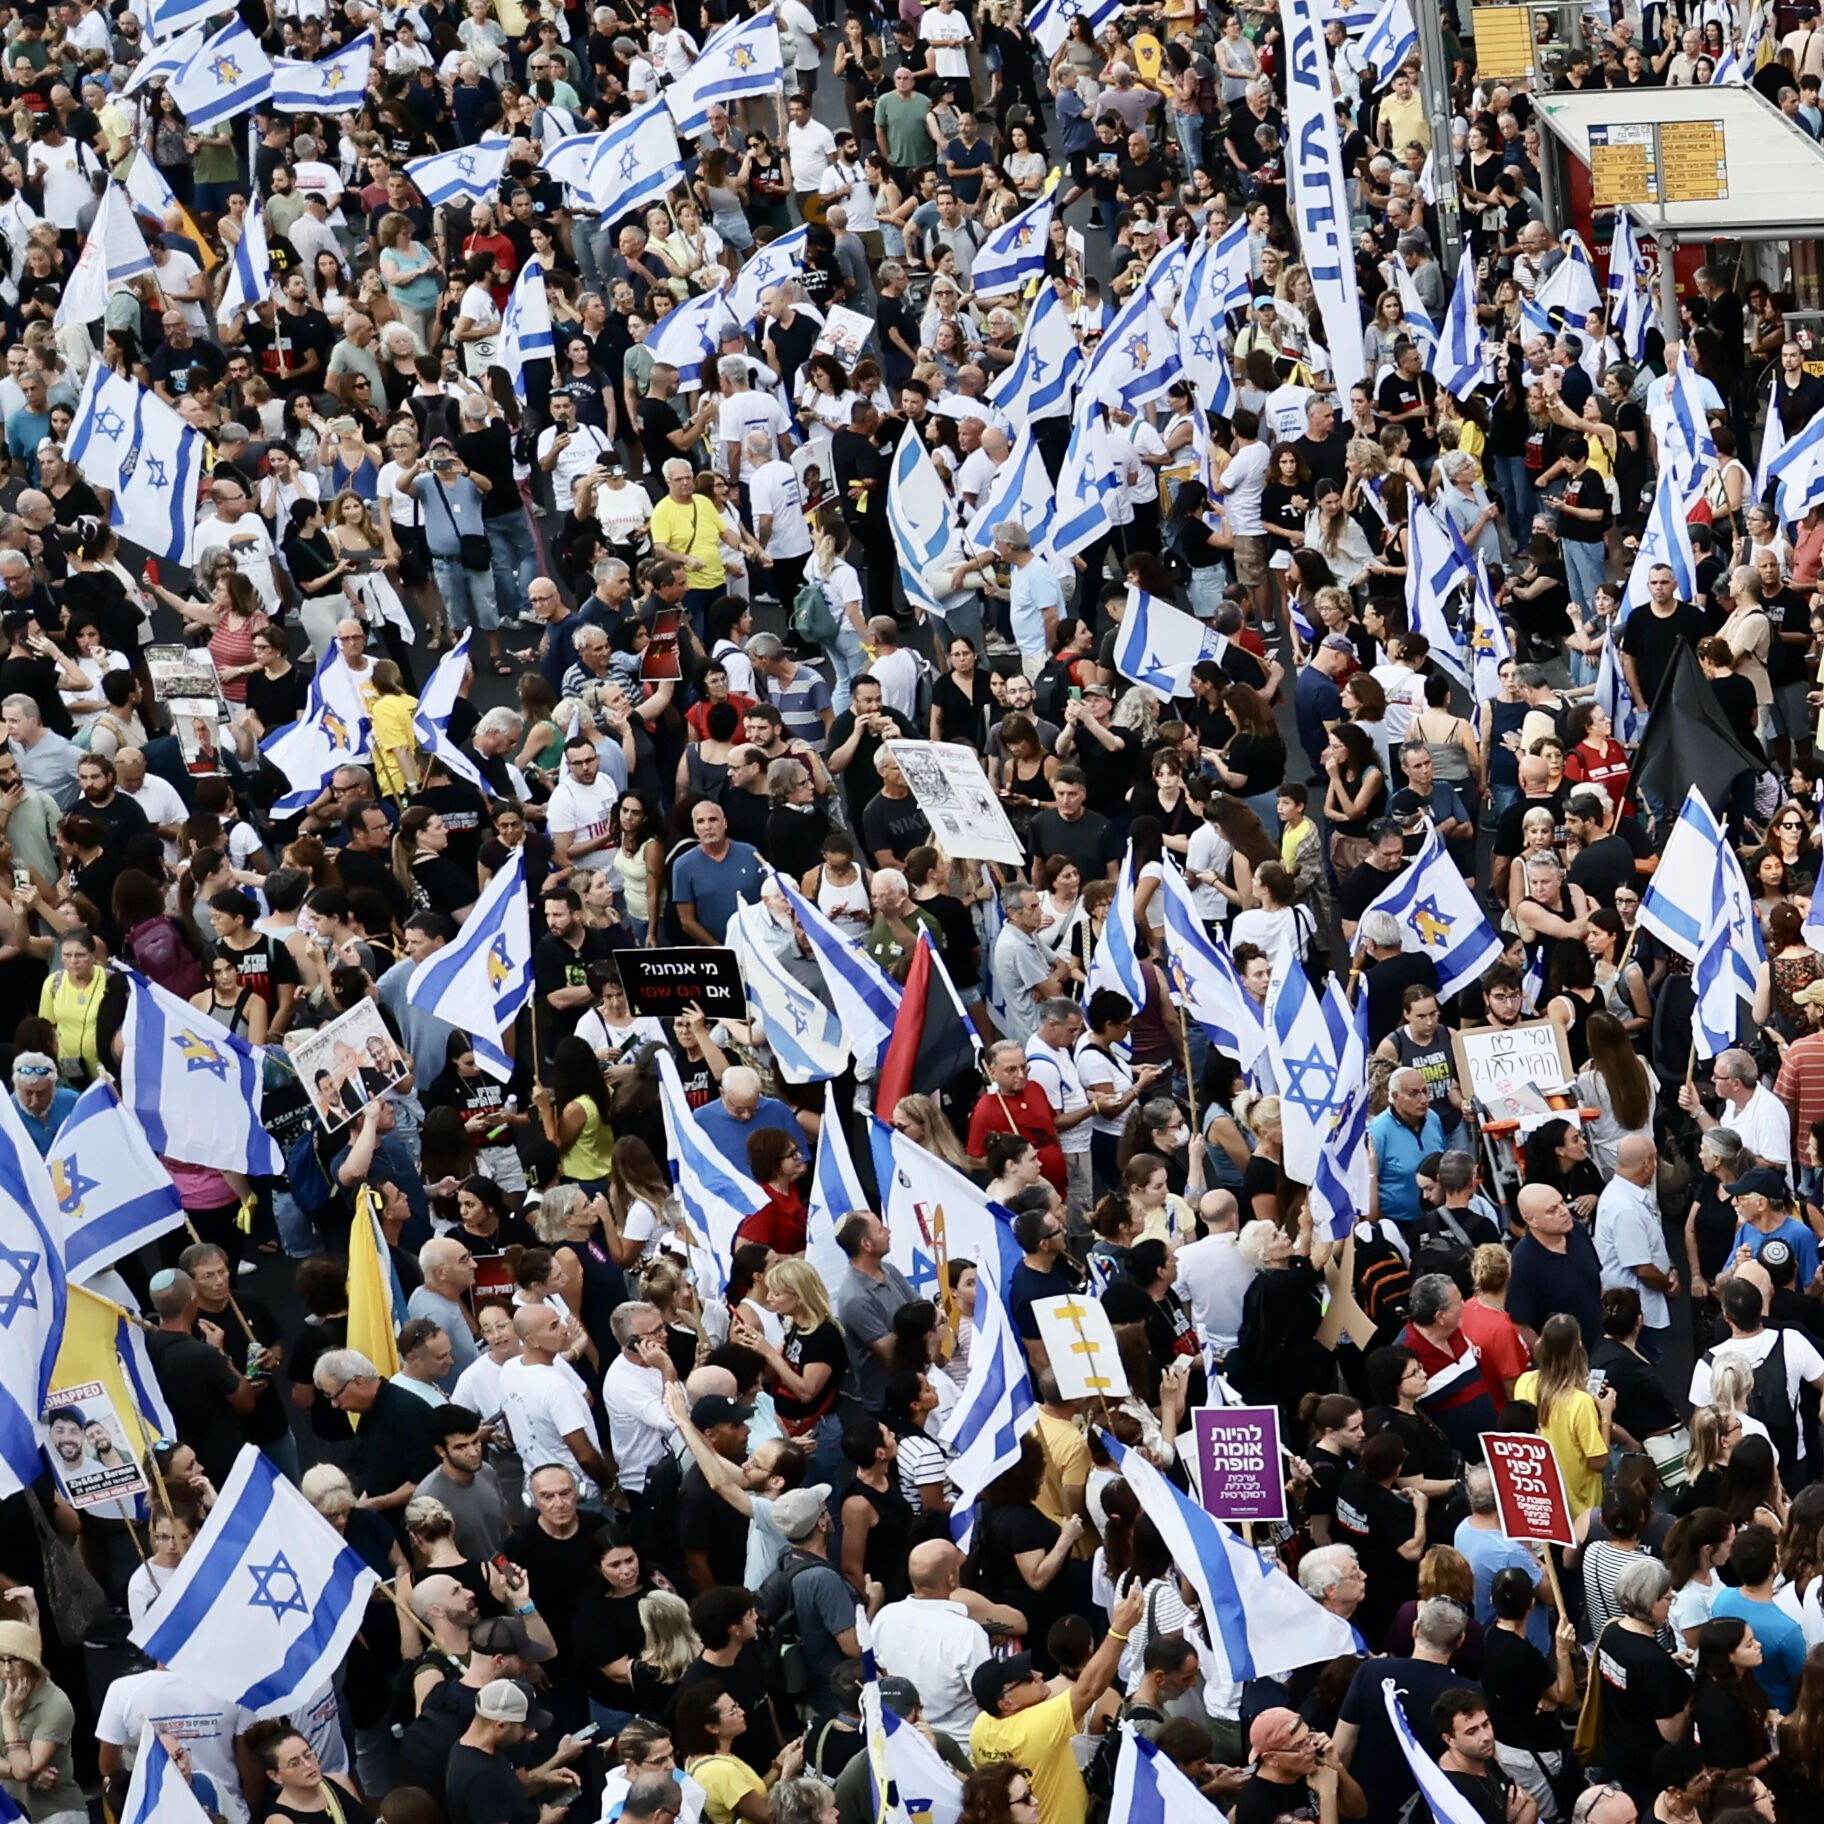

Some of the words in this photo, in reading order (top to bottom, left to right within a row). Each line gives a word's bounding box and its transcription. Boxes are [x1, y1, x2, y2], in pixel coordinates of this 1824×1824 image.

[640, 962, 696, 976] אנחנו?
[700, 963, 718, 975] מי
[706, 985, 730, 998] אם
[1210, 1424, 1262, 1441] להיות
[1212, 1442, 1264, 1457] אומת
[1493, 1441, 1547, 1460] ערכים
[1214, 1457, 1265, 1472] מופת
[1506, 1459, 1543, 1477] לפני
[104, 1464, 136, 1481] Berman
[1511, 1473, 1547, 1495] הכל
[1220, 1490, 1266, 1501] דמוקרטית
